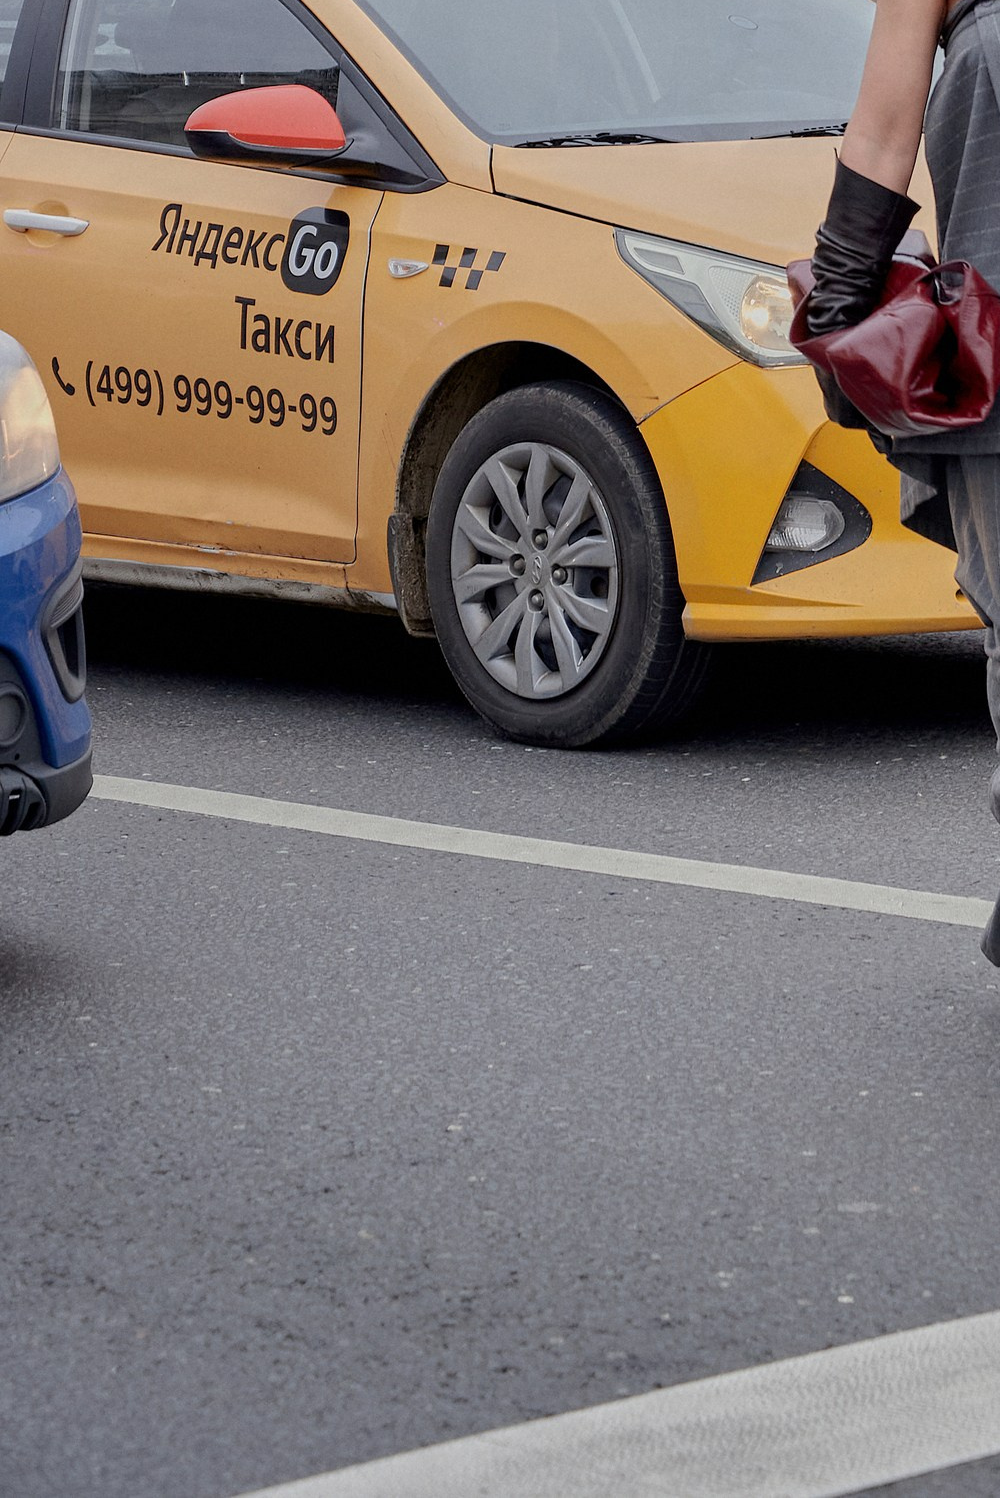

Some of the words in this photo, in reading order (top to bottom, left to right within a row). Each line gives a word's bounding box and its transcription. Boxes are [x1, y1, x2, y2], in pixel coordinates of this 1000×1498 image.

[151, 203, 285, 271] Яндекс
[288, 224, 339, 279] Go
[234, 295, 335, 363] Такси
[85, 360, 164, 416] (499)
[173, 374, 338, 436] 999-99-99
